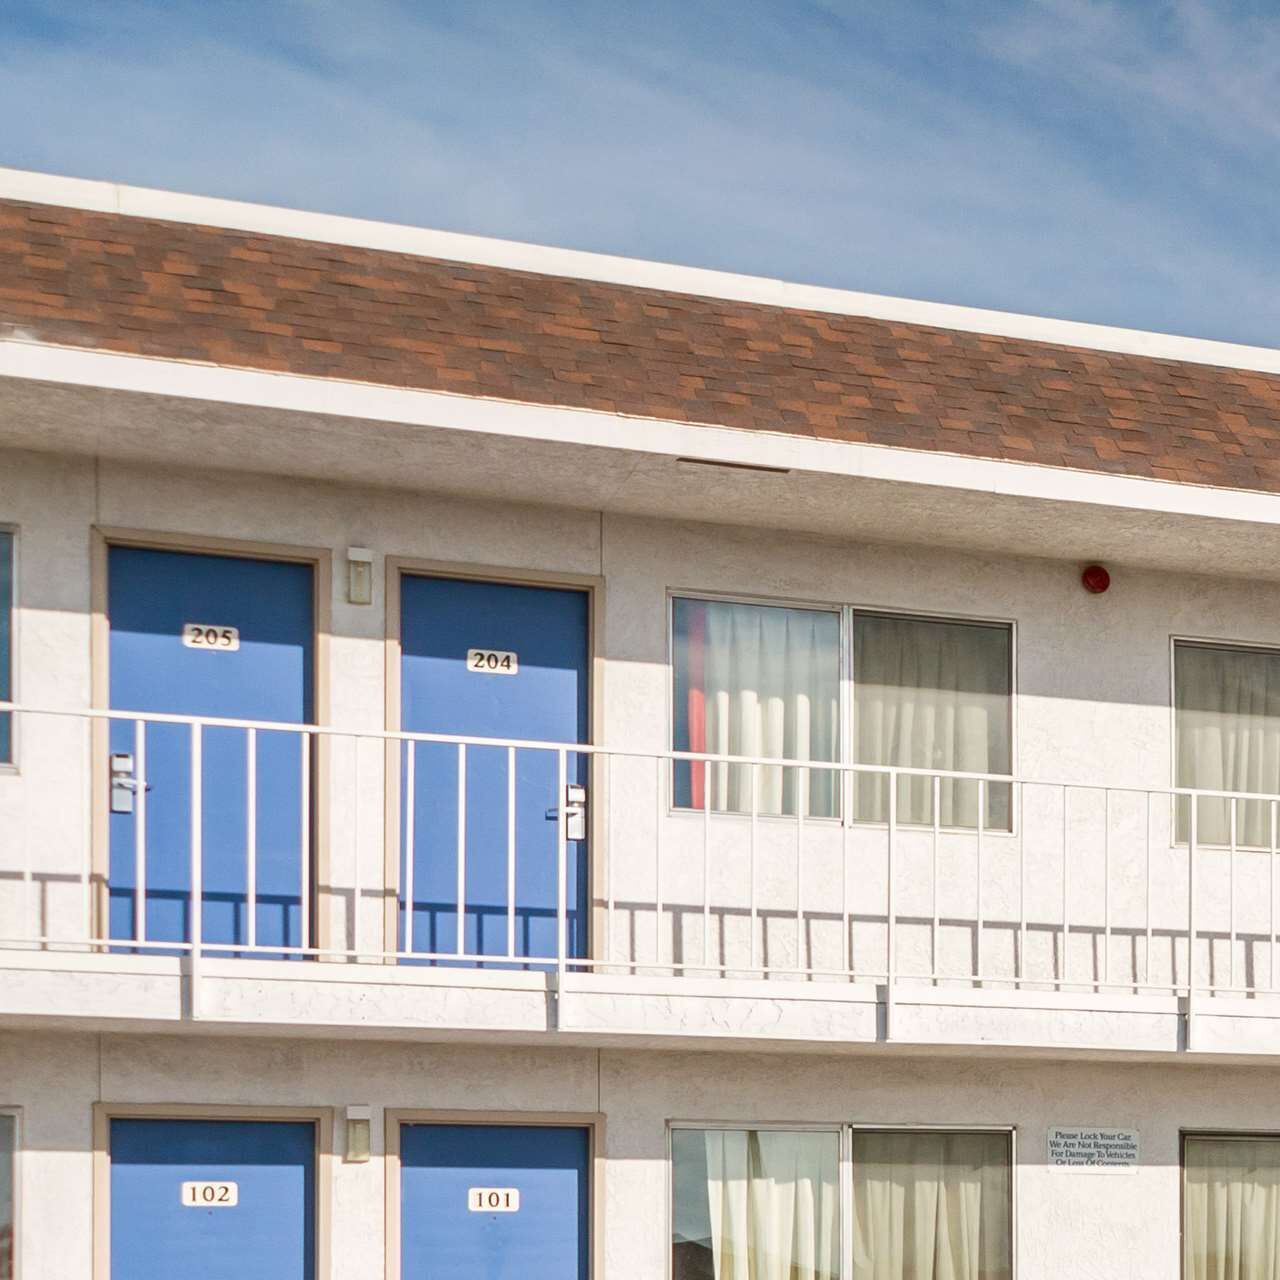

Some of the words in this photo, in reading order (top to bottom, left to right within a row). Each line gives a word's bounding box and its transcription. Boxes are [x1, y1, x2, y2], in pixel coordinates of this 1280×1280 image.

[190, 627, 232, 646] 205
[473, 652, 513, 670] 204
[1055, 1131, 1078, 1140] Please
[1080, 1132, 1098, 1140] Lock
[1100, 1132, 1116, 1140] Your
[1117, 1132, 1131, 1140] Car
[1049, 1140, 1061, 1149] We
[1062, 1140, 1077, 1149] Are
[1078, 1141, 1092, 1149] Not
[1093, 1141, 1137, 1151] Responsible
[1051, 1150, 1064, 1158] For
[1065, 1150, 1096, 1160] Damage
[1096, 1150, 1105, 1158] To
[1106, 1150, 1136, 1159] Vehicles
[191, 1186, 229, 1202] 102
[477, 1192, 511, 1207] 101
